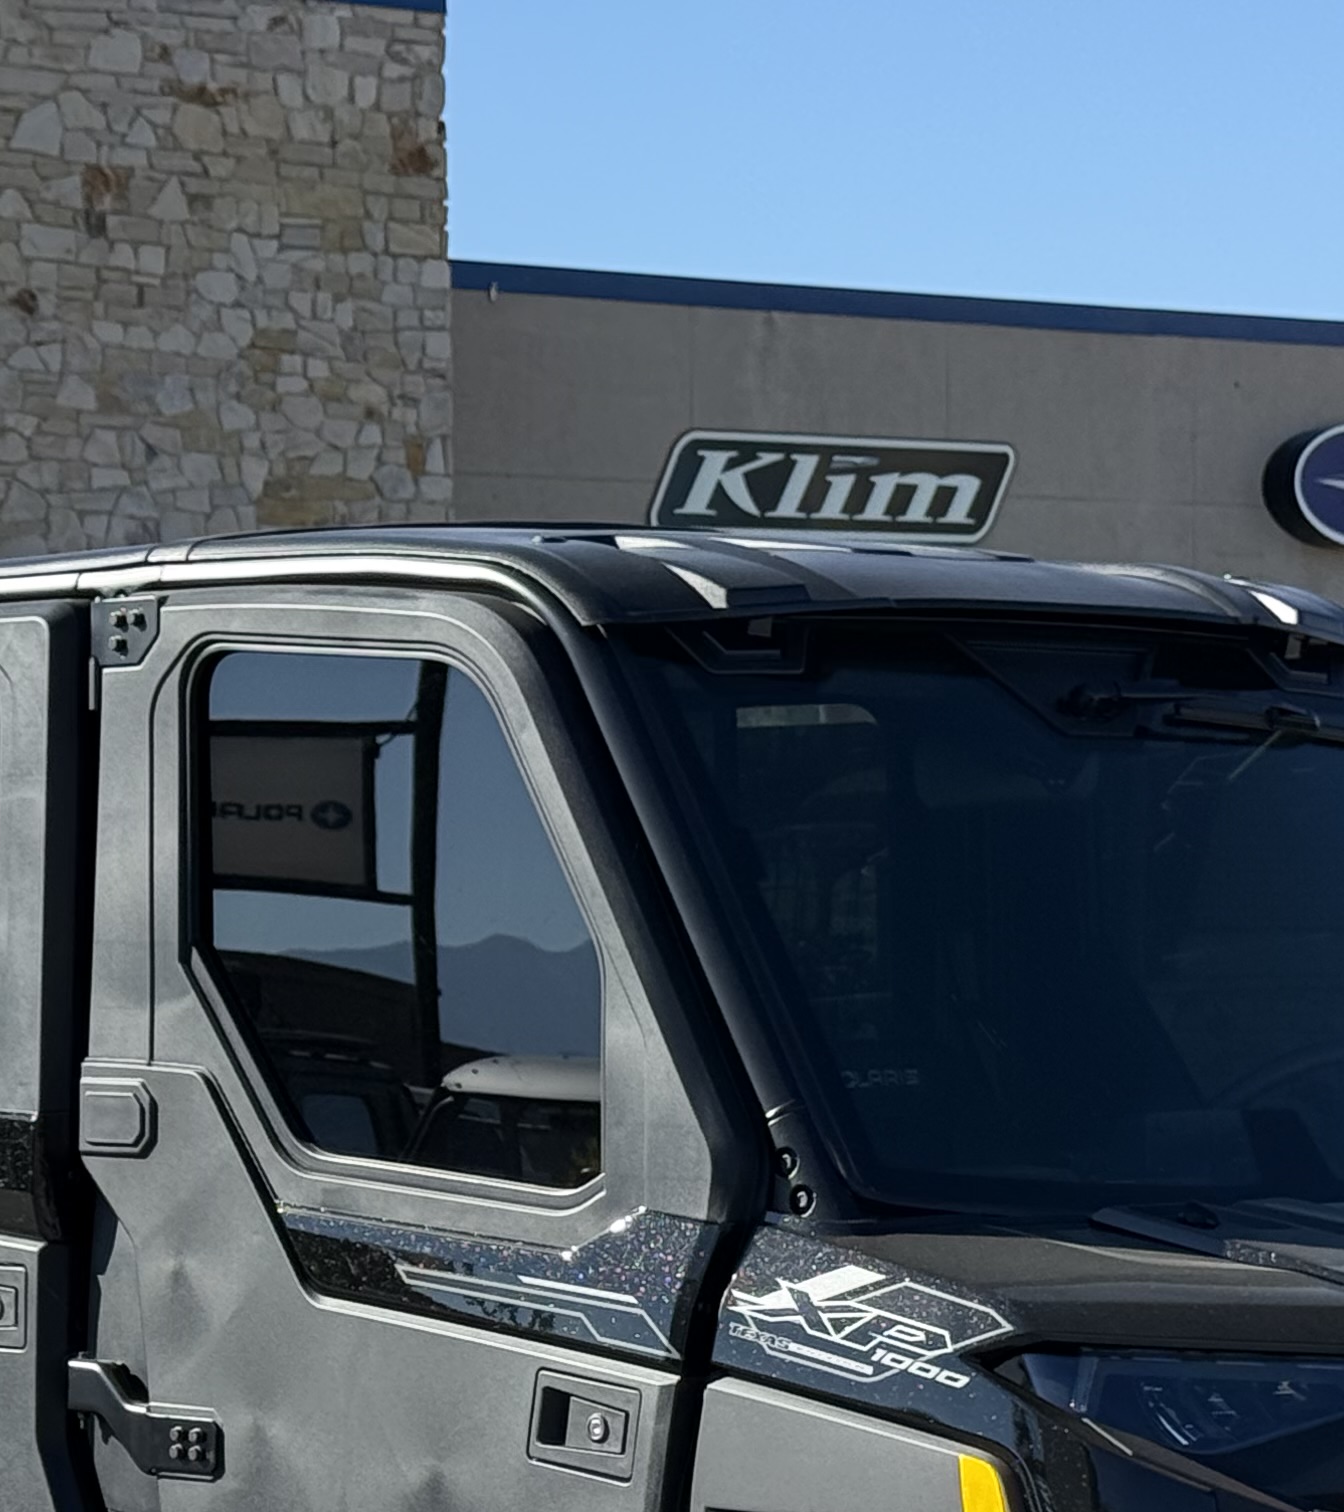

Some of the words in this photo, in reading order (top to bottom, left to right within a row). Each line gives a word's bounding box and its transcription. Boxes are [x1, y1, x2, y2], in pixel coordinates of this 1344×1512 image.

[673, 449, 982, 525] Klim
[728, 1321, 793, 1352] TEXAS
[870, 1348, 971, 1389] 1000
